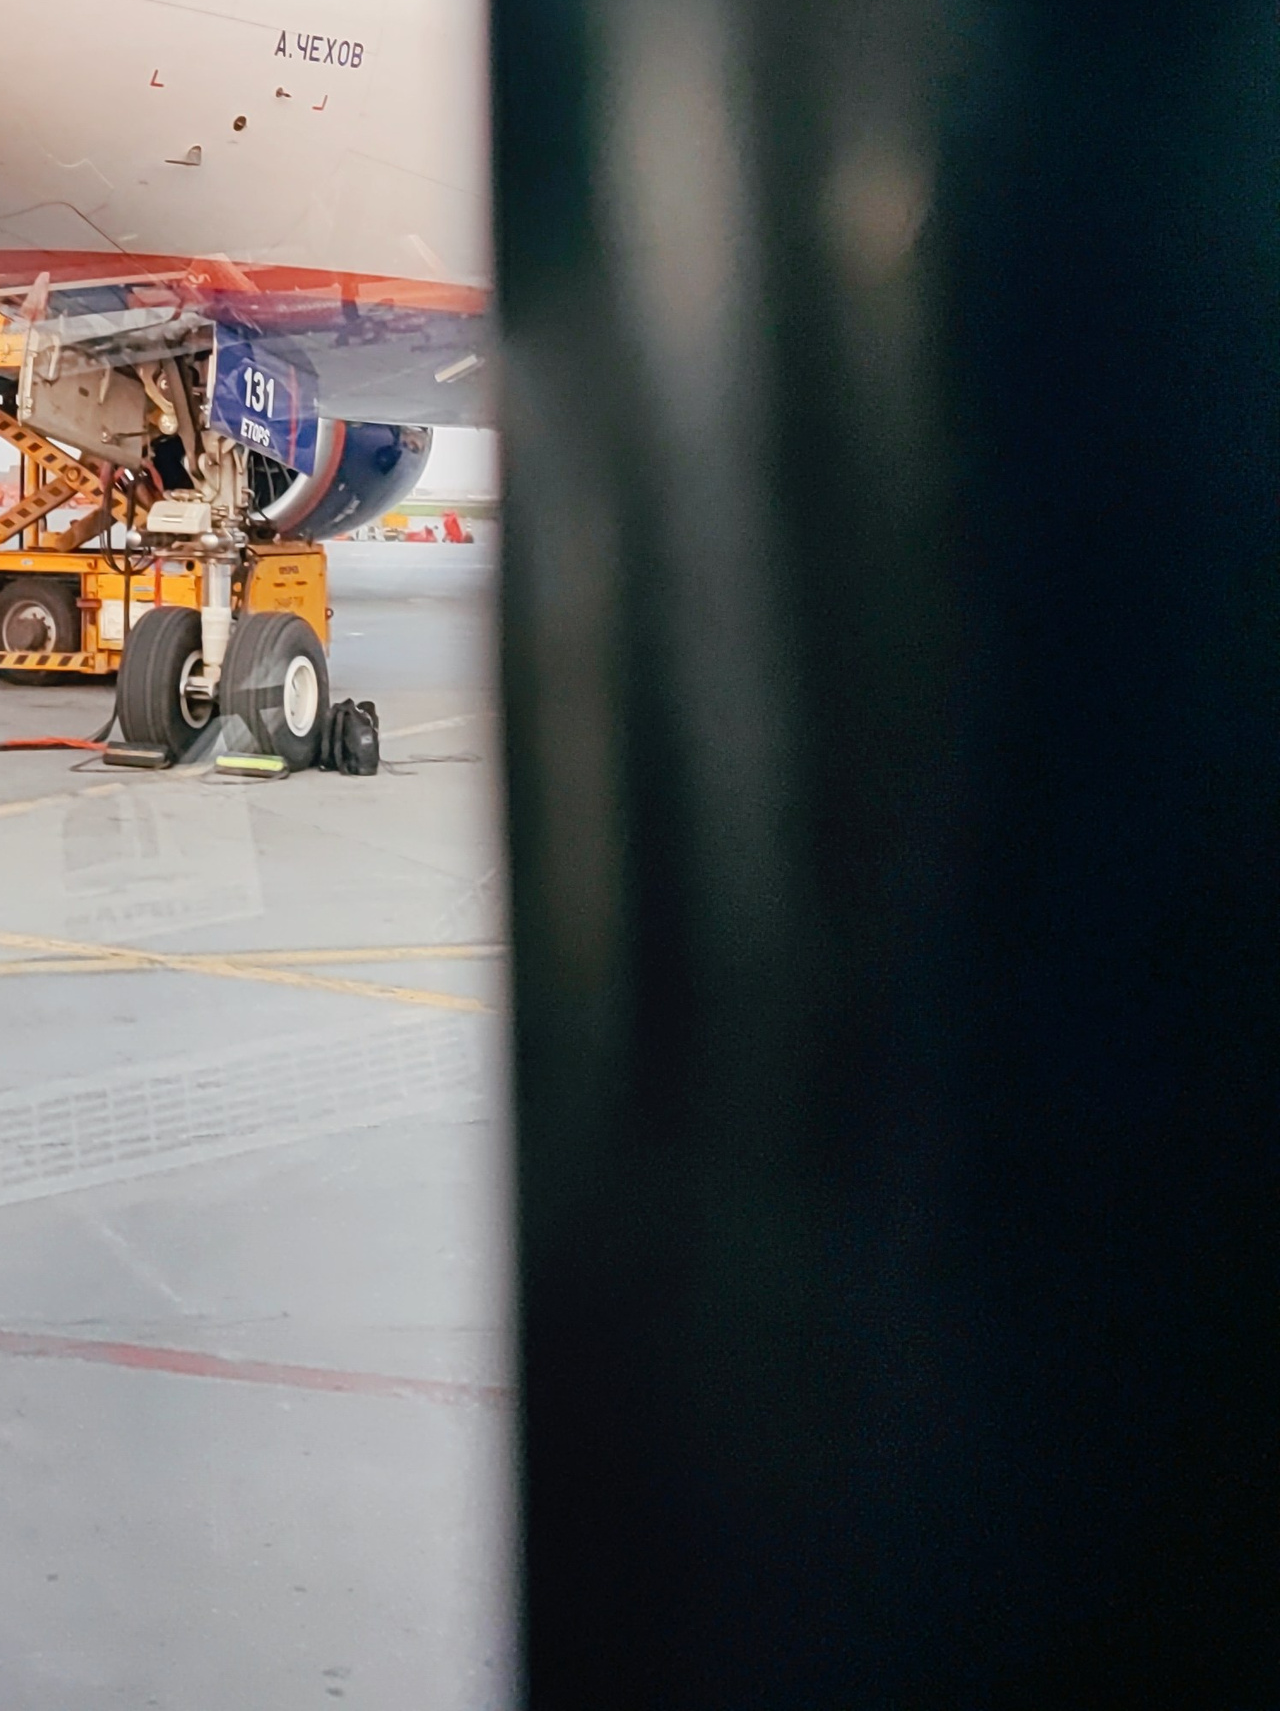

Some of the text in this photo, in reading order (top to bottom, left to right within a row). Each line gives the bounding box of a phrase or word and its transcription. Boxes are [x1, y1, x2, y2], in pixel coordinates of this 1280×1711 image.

[274, 30, 364, 68] А.ЧЕХОВ
[244, 367, 275, 418] 131
[240, 417, 271, 447] ETOPS
